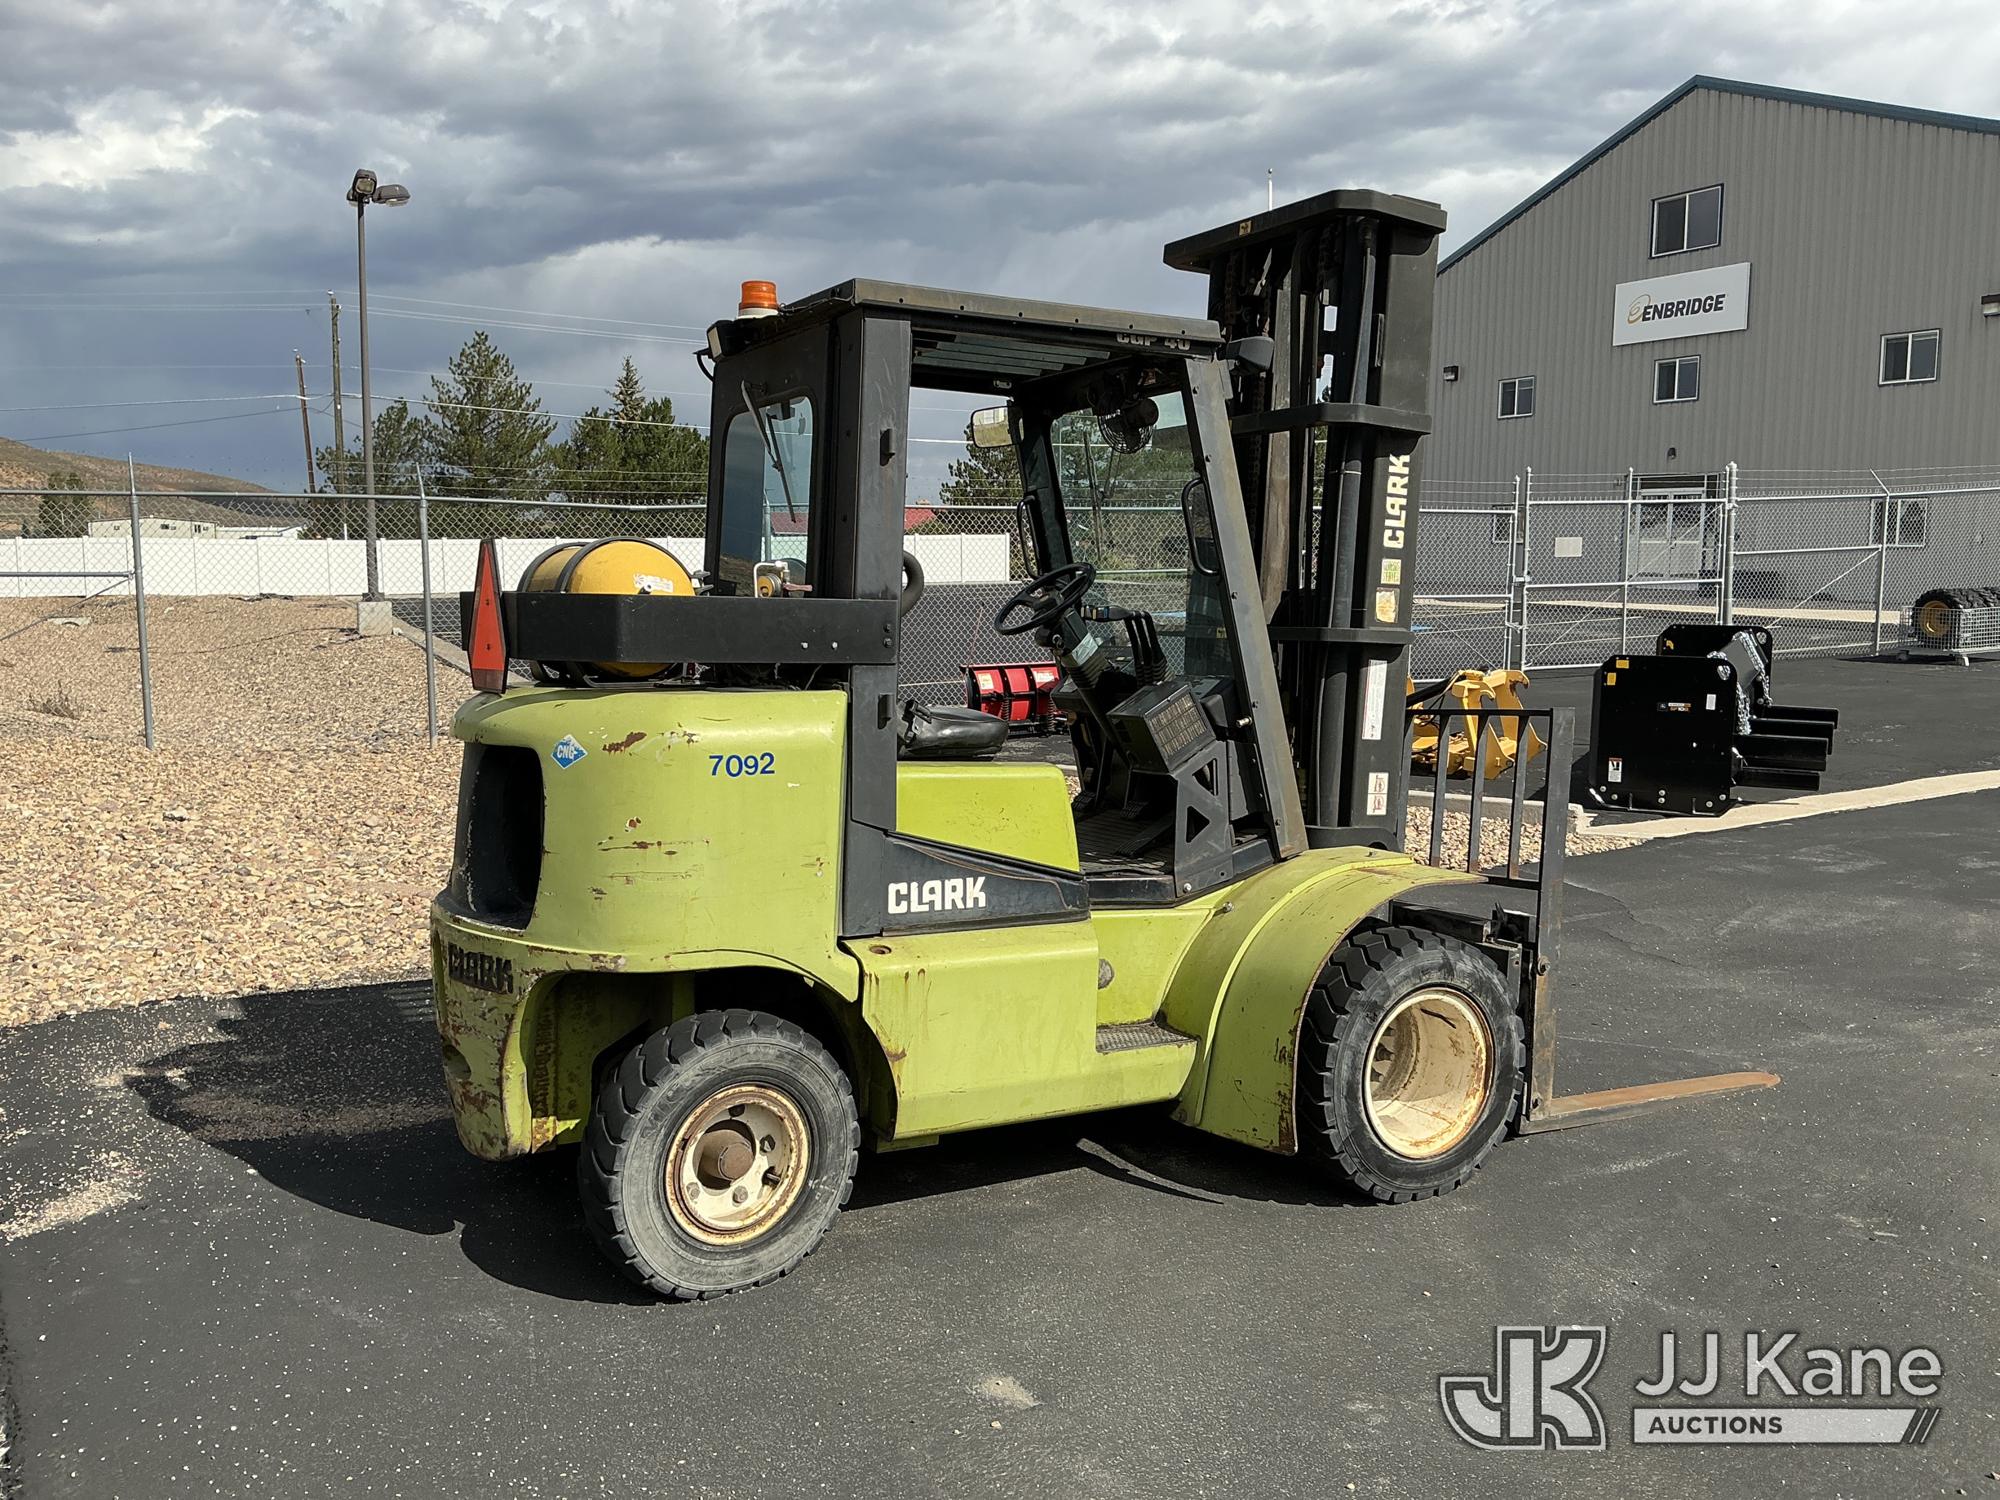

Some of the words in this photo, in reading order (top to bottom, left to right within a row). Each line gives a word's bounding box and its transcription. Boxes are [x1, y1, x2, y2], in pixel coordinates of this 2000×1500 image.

[1642, 294, 1726, 321] ENBRIDGE
[1383, 453, 1411, 549] CLARK
[556, 744, 576, 761] CNG
[709, 752, 775, 777] 7092
[887, 876, 987, 914] CLARK
